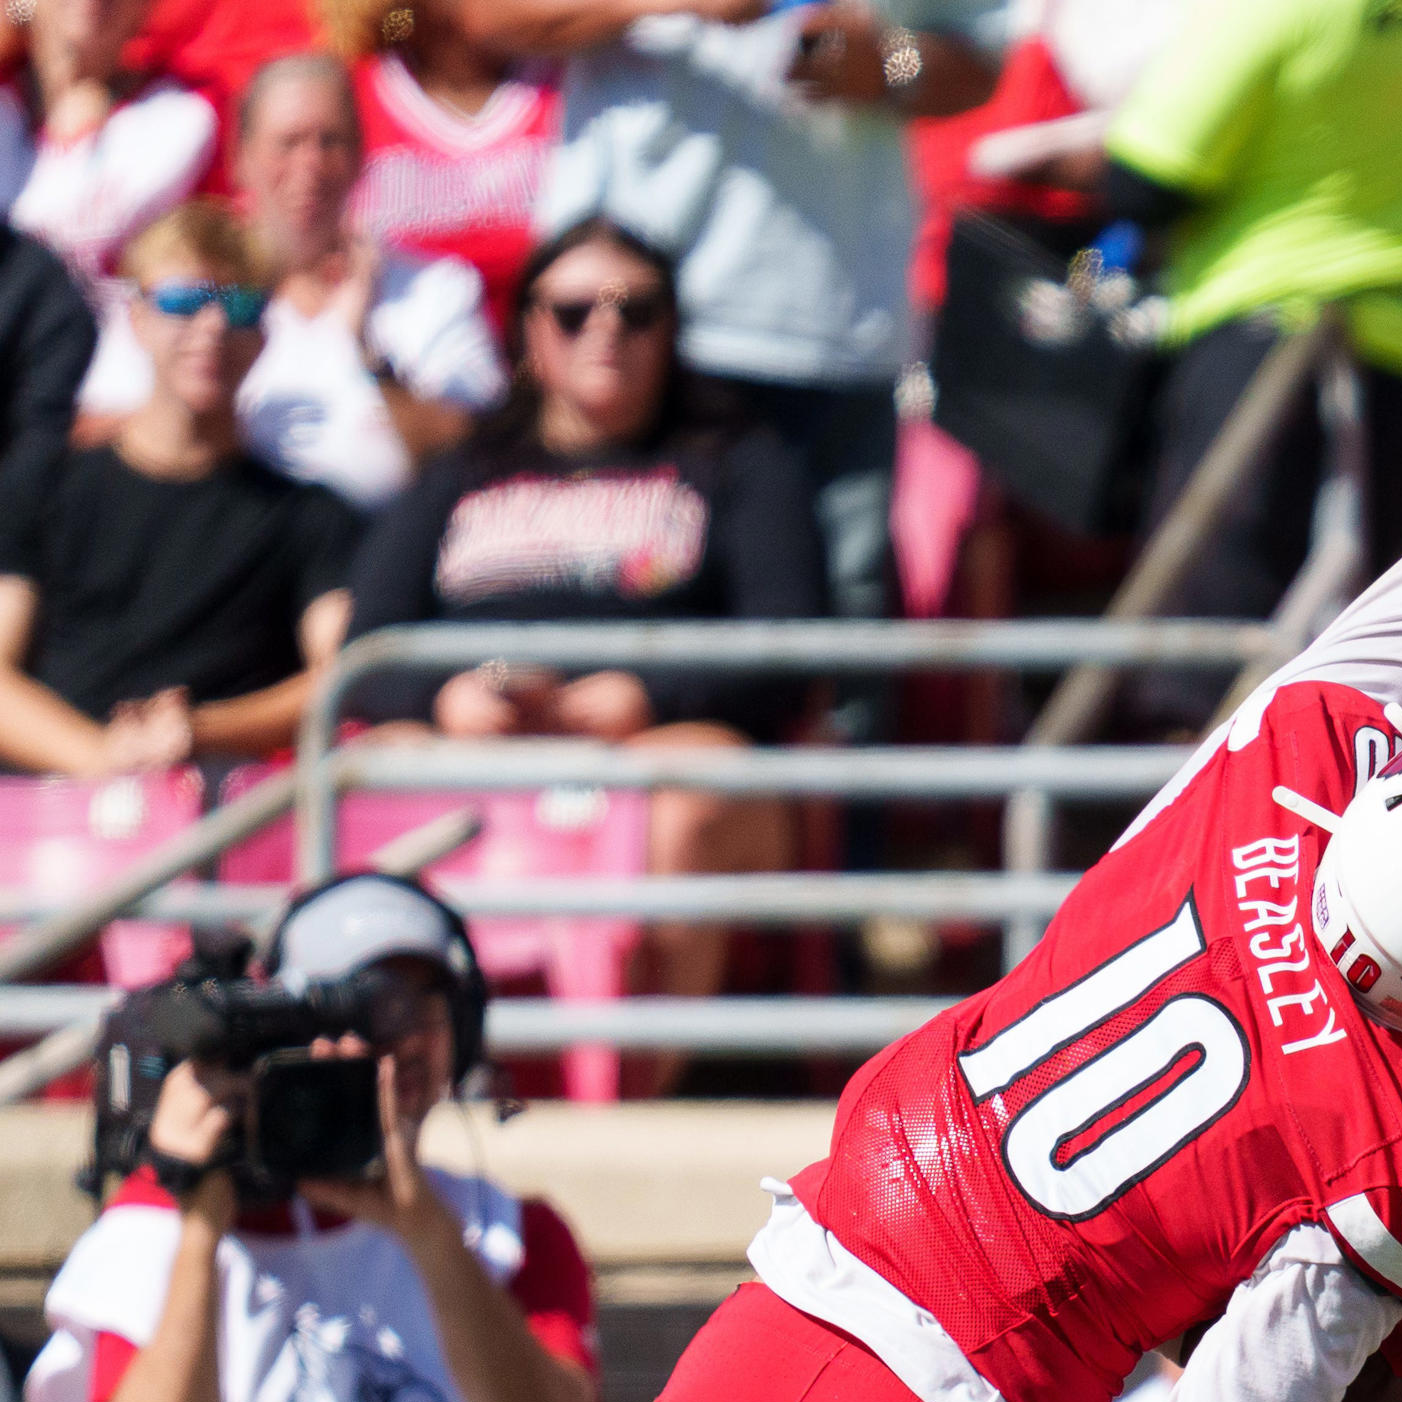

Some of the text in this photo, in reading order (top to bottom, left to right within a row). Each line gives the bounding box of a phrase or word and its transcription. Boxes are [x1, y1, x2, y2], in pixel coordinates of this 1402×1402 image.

[957, 883, 1251, 1223] 10
[1232, 833, 1348, 1055] BEASLEY
[1330, 924, 1382, 994] 10
